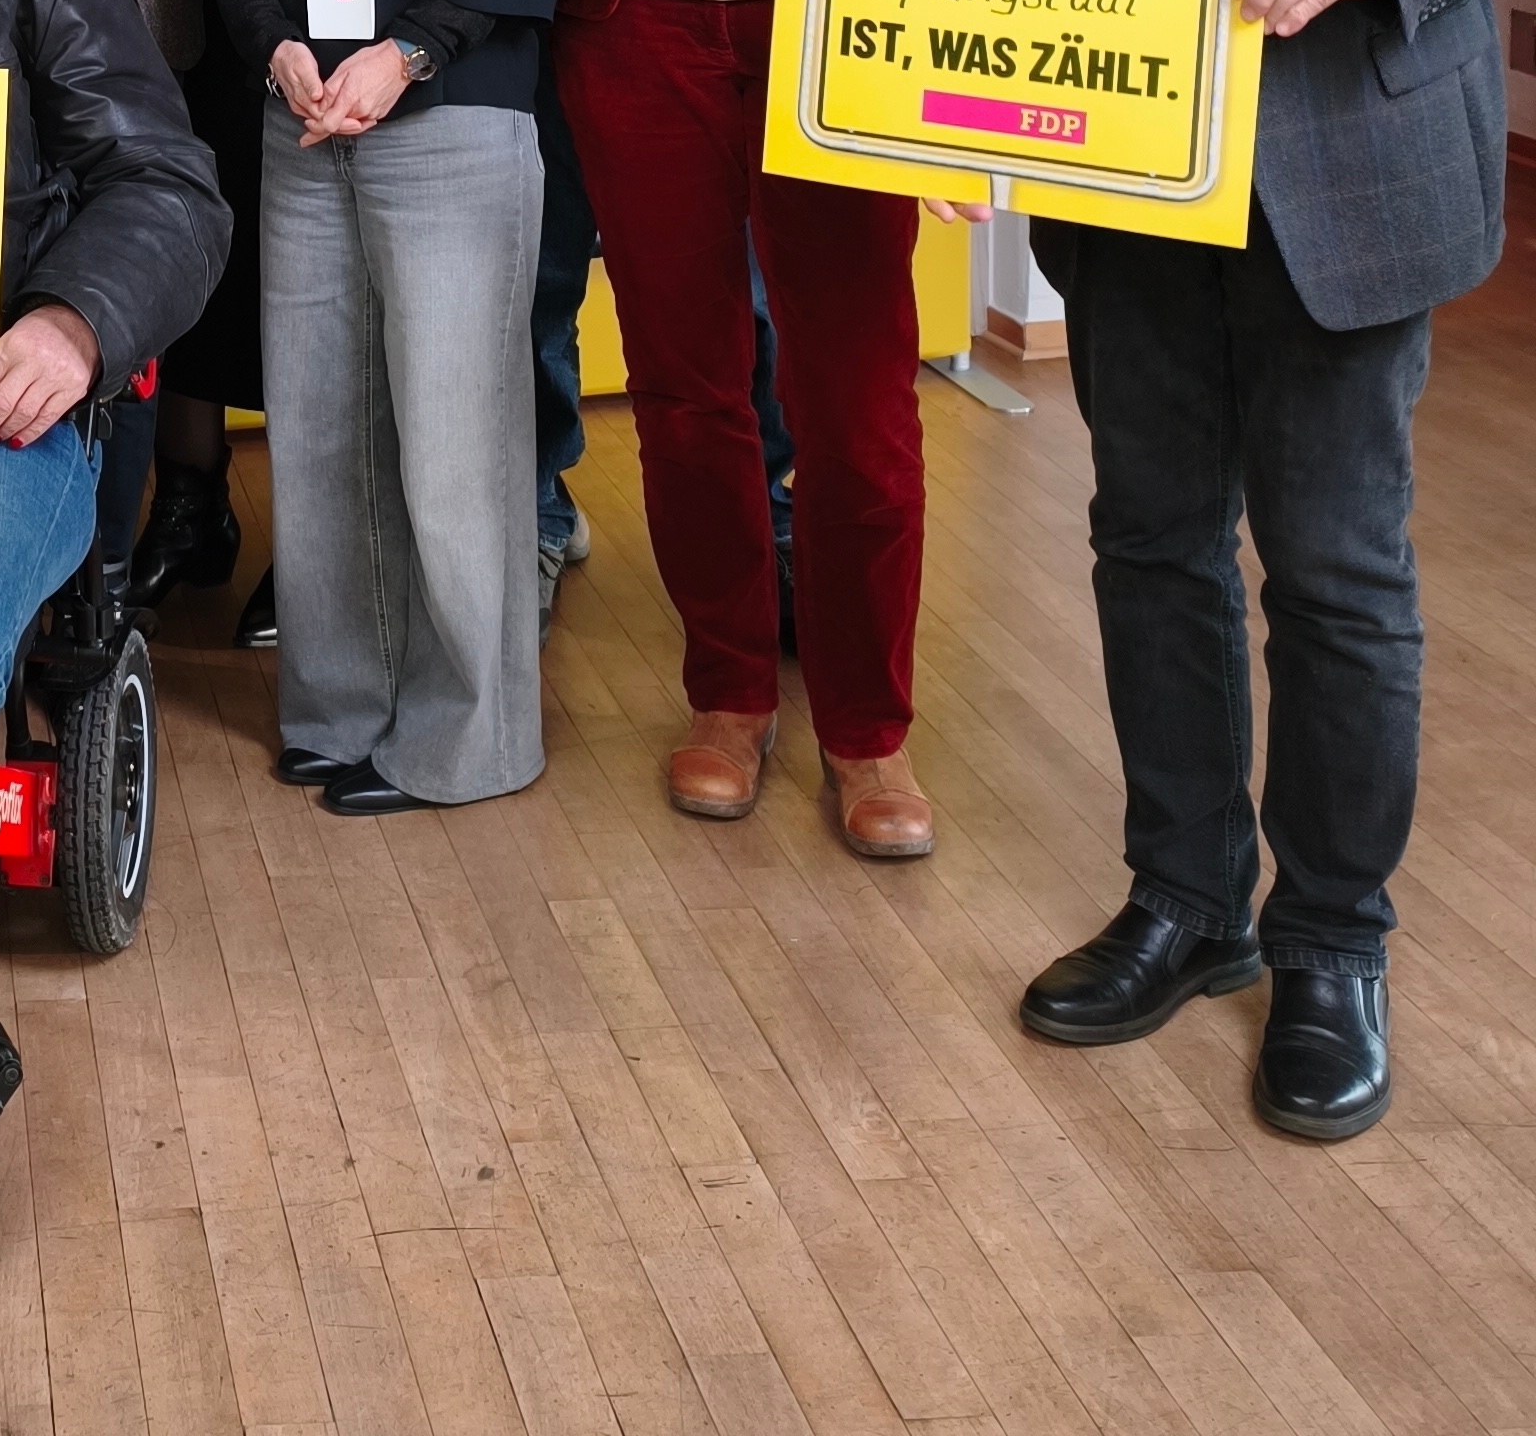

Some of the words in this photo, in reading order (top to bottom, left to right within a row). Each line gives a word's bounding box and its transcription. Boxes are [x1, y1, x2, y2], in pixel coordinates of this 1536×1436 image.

[839, 16, 913, 71] IST,
[927, 27, 1018, 79] WAS
[1028, 32, 1179, 101] ZÄHLT.
[1018, 108, 1082, 139] FDP
